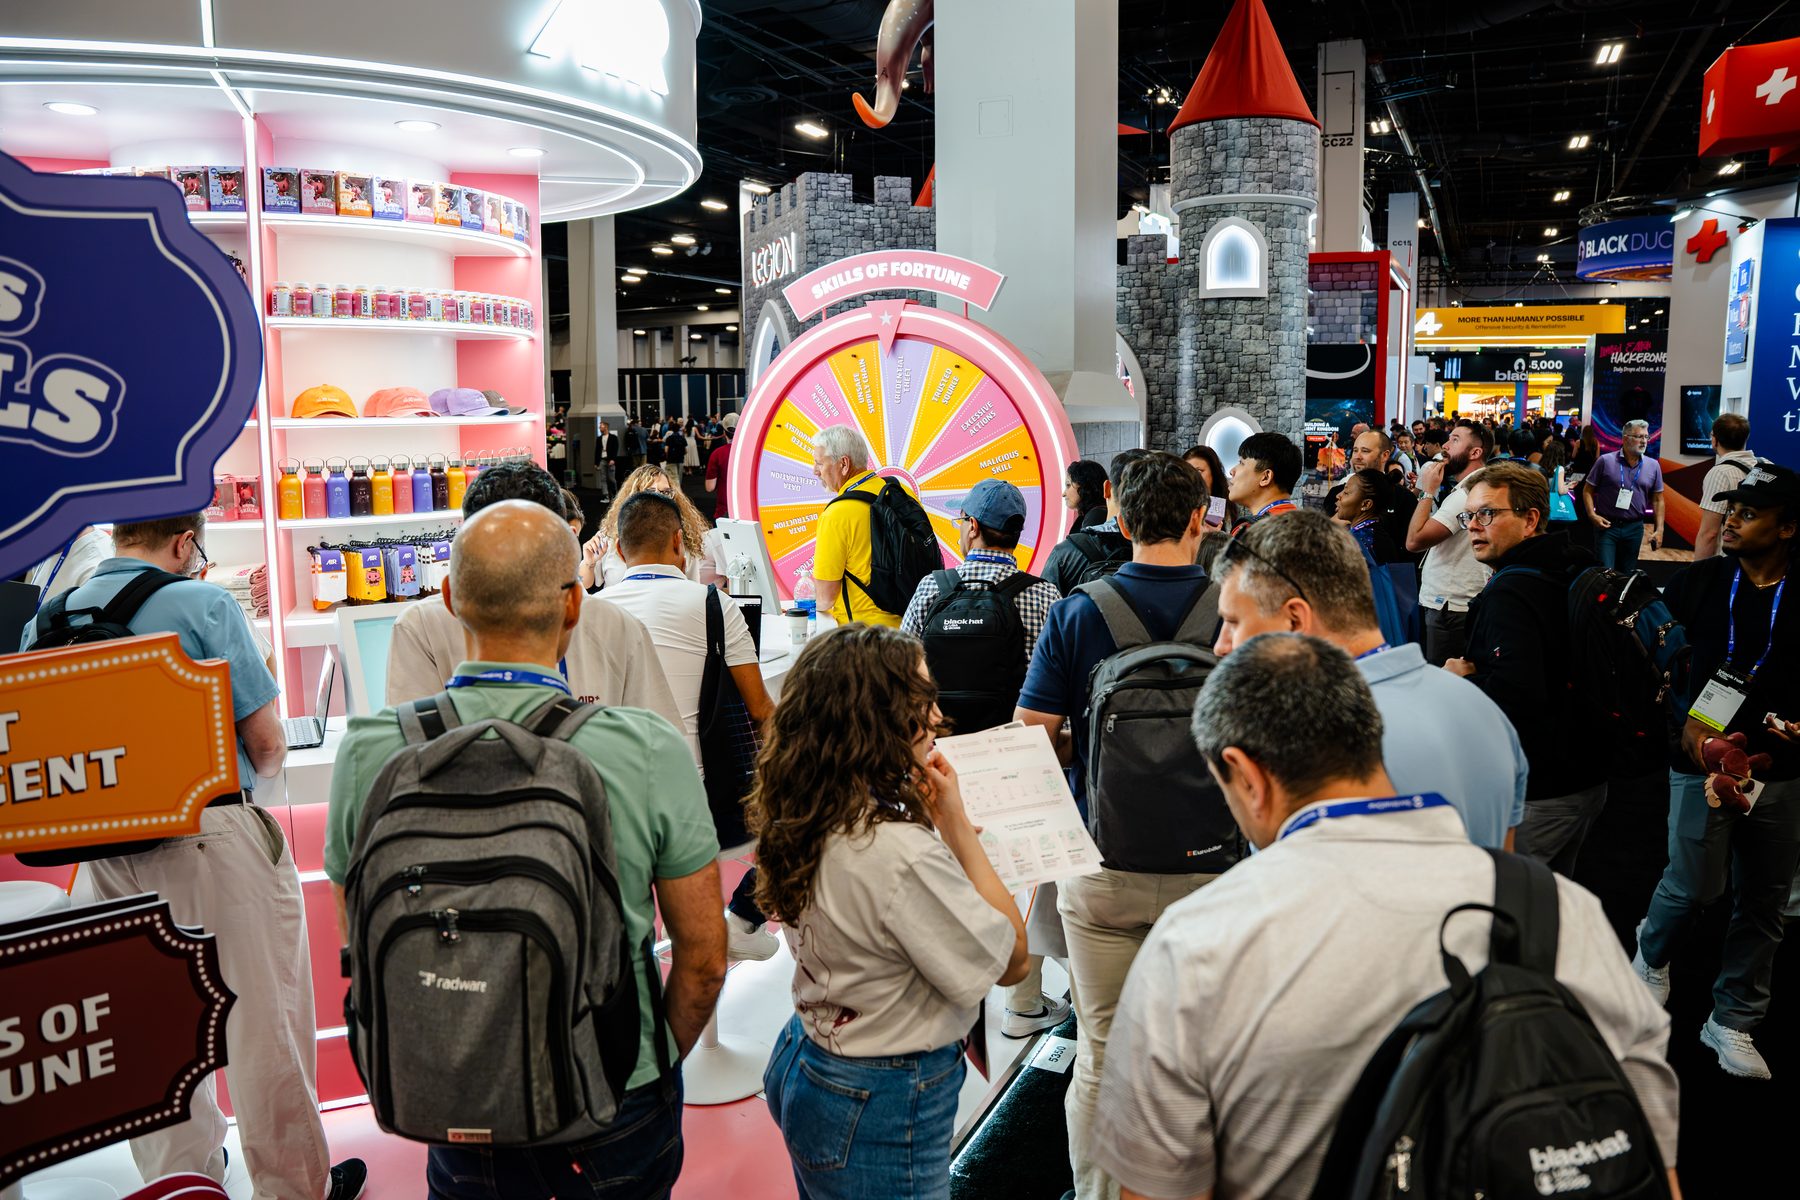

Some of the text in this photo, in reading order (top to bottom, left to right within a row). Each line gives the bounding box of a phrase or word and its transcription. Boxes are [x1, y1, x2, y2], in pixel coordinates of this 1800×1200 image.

[1322, 137, 1353, 147] CC22
[1585, 230, 1673, 258] BLACK DUC
[752, 232, 796, 288] LEGION
[811, 262, 972, 299] SKILLS OF FORTUNE
[1528, 360, 1563, 370] 5,000
[854, 373, 864, 404] UNSAFE
[858, 358, 874, 414] SUPPLY CHAIN
[894, 356, 904, 404] CREDENTIAL
[932, 368, 952, 403] TRUSTED
[943, 377, 960, 406] SOURCE
[811, 392, 830, 418] HIDDEN
[815, 384, 840, 417] BEHAVIOR
[960, 401, 994, 431] EXCESSIVE
[970, 411, 996, 436] ACTIONS
[980, 450, 1020, 469] MALICIOUS
[991, 464, 1013, 476] SKILL
[770, 472, 817, 486] EXFILTRATION
[784, 483, 800, 492] DATA
[774, 514, 818, 530] DESTRUCTION
[789, 526, 806, 534] DATA
[436, 977, 487, 992] radware
[41, 992, 110, 1043] OF
[1048, 1046, 1066, 1062] 5350
[0, 1038, 116, 1105] UNE
